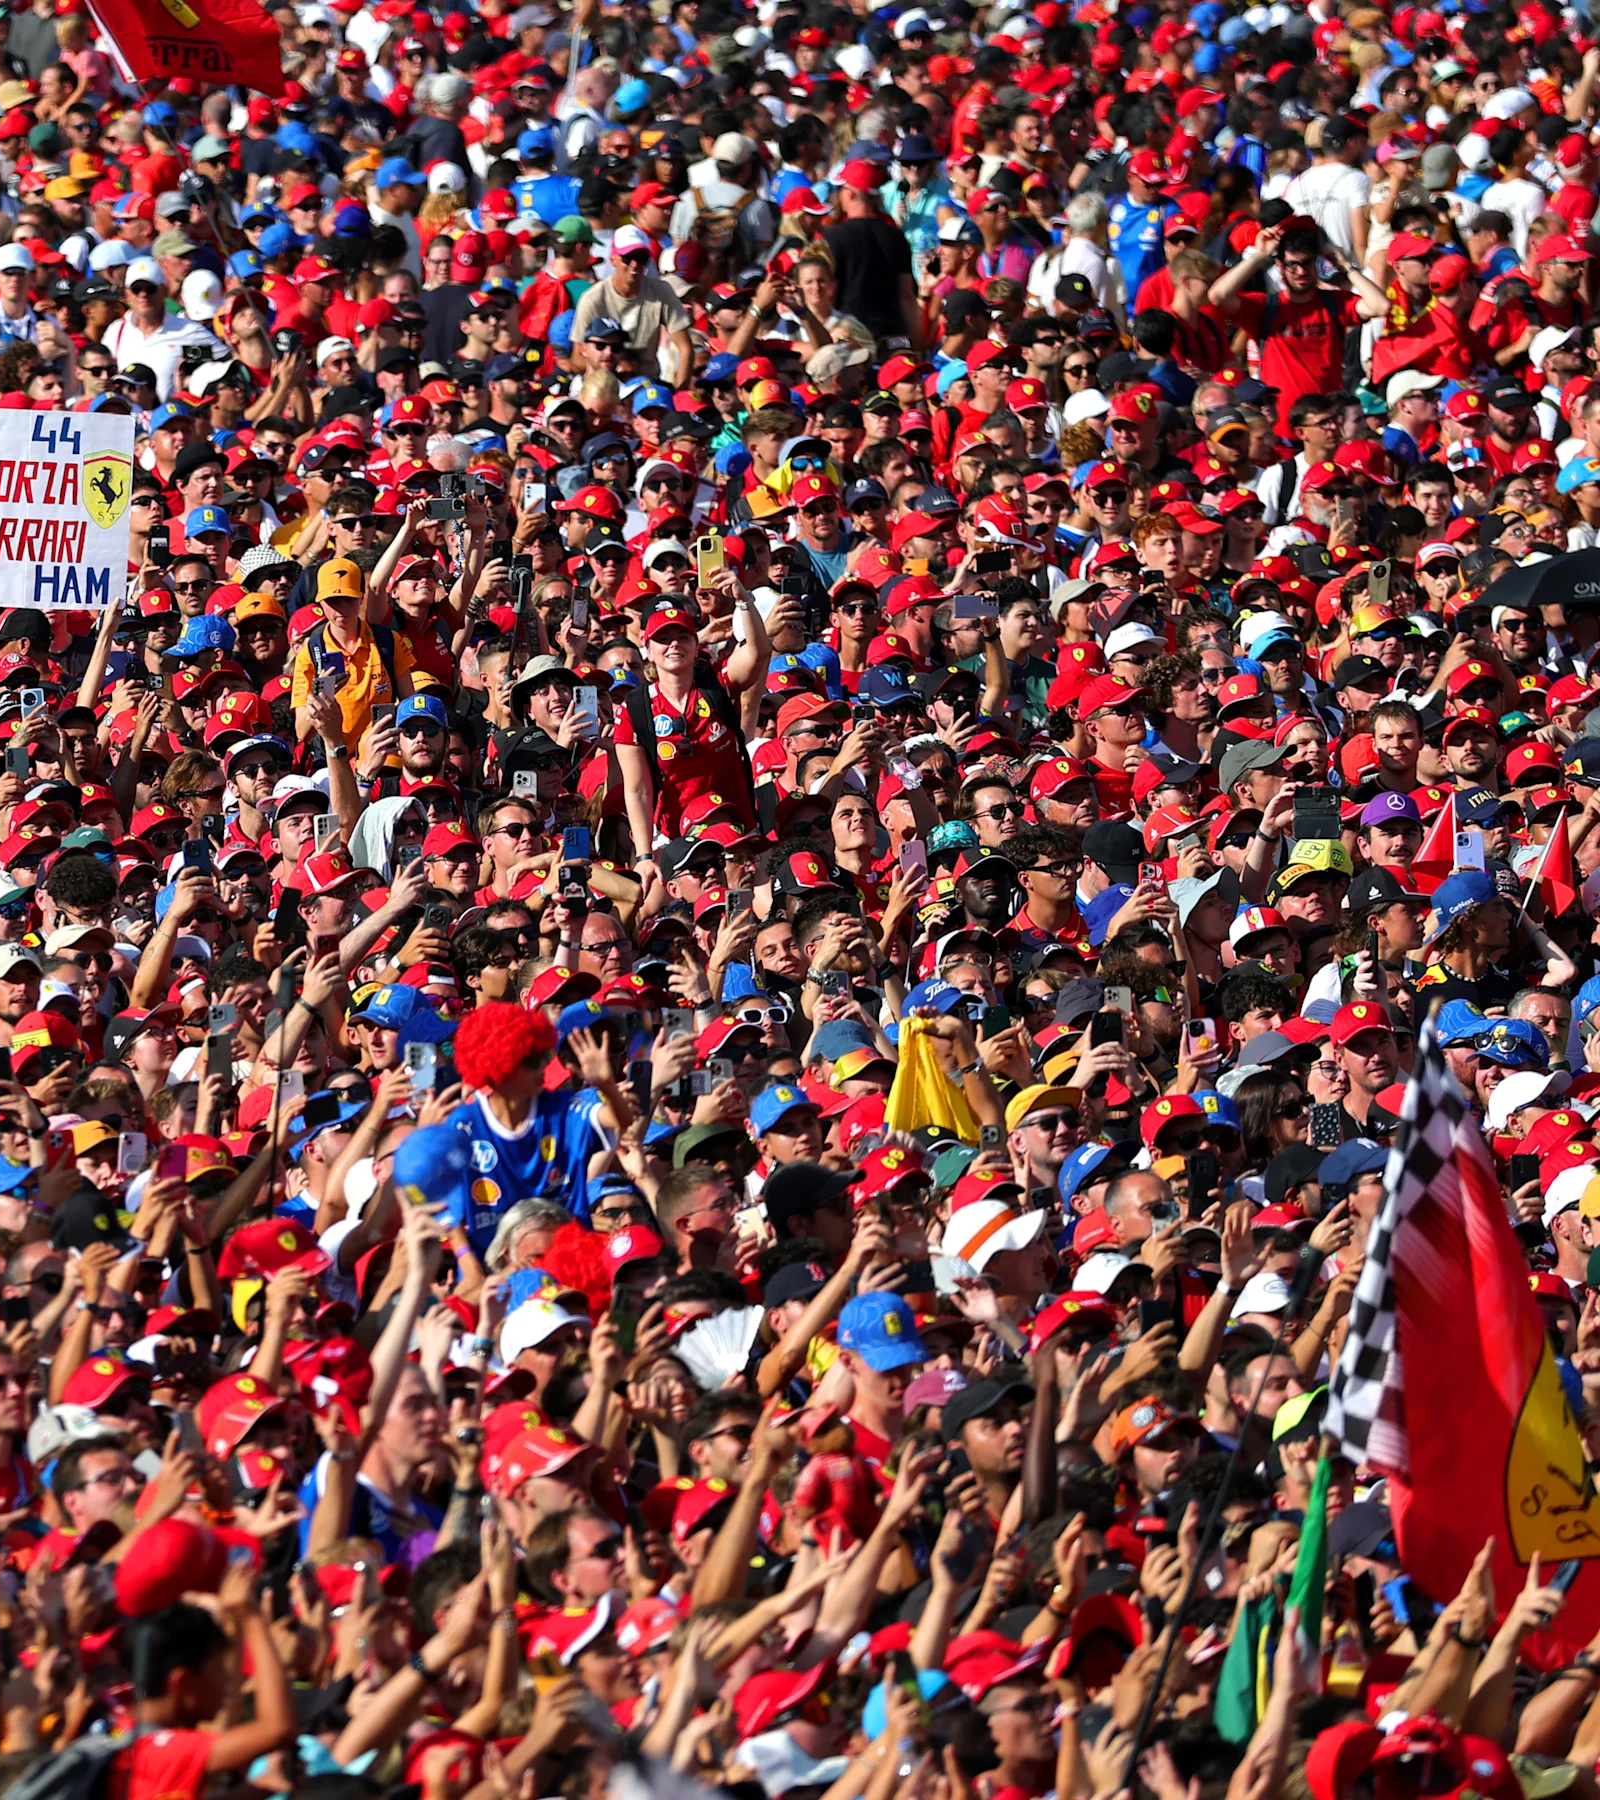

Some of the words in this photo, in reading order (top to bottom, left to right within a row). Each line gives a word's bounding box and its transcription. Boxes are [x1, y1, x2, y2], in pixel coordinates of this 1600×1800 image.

[31, 414, 81, 455] 44
[33, 564, 111, 605] HAM
[884, 671, 904, 687] W
[655, 716, 670, 736] hp
[1449, 898, 1475, 914] CarNext
[9, 945, 26, 958] NY
[472, 1140, 494, 1173] hp
